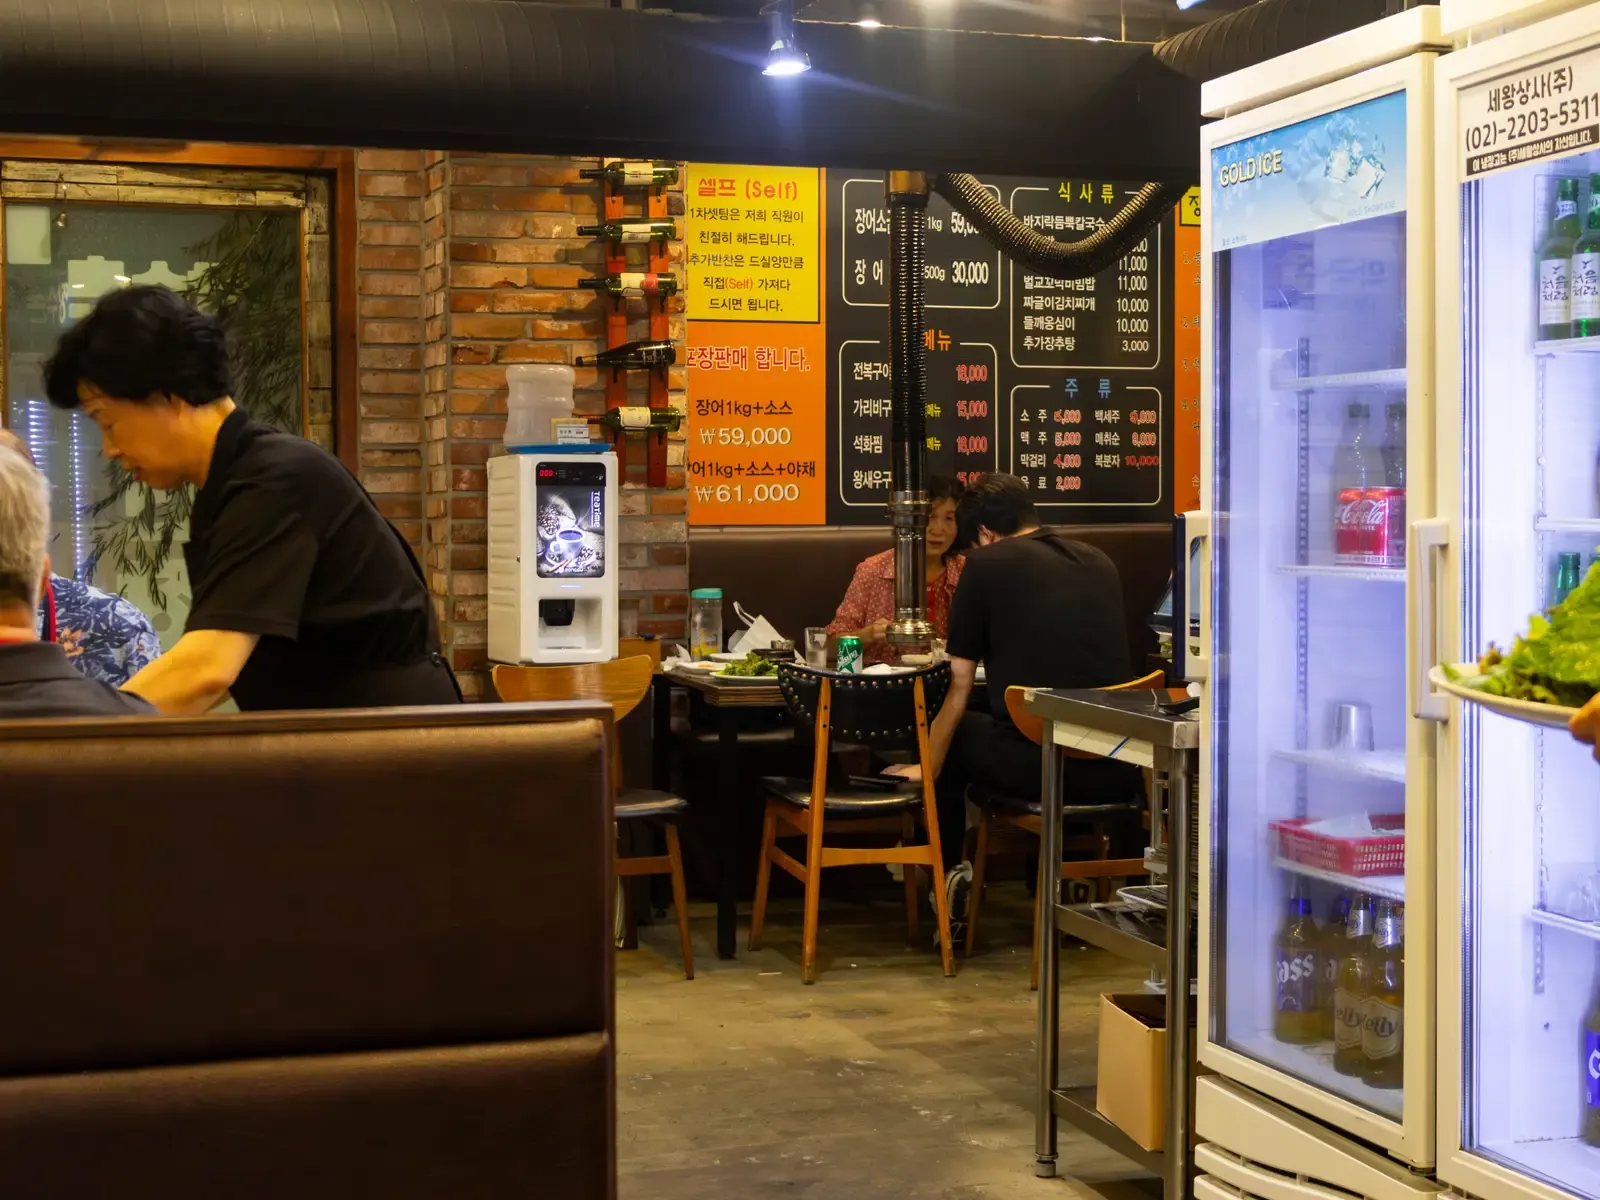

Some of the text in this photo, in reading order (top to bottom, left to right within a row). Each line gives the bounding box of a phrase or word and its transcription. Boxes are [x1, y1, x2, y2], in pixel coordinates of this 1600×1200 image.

[1487, 66, 1572, 112] 세왕상사(주)
[1466, 92, 1599, 151] (02)-2203-5311
[1219, 149, 1283, 187] GOLD ICE
[698, 178, 798, 200] 셀프 (Self)
[690, 207, 804, 223] 1차셋팅은 저희 직원이
[855, 208, 890, 234] 장어소
[927, 216, 942, 232] 1kg
[1023, 214, 1106, 231] 바지락듬뿍칼국수
[699, 230, 795, 246] 친절히 해드립니다.
[689, 253, 804, 269] 추가반찬은 드실양만큼
[952, 261, 989, 287] 30,000
[703, 276, 790, 291] 직접(Self) 가져다
[1118, 276, 1148, 292] 11,000
[709, 298, 784, 312] 드시면 됩니다.
[1023, 295, 1149, 314] 짜글이김치찌개 10,000
[1023, 316, 1149, 334] 들깨옹심이 10,000
[1023, 335, 1149, 352] 추가장추탕 3,000
[754, 346, 811, 371] 합니다.
[696, 399, 793, 417] 장어1kg+소스
[853, 399, 892, 418] 가리비구
[1094, 410, 1120, 424] 백세주
[700, 427, 792, 447] ₩59,000
[853, 435, 883, 454] 석화찜
[687, 460, 816, 478] 어1kg+소스+야채
[1020, 454, 1047, 468] 막걸리
[1094, 454, 1120, 468] 복분자
[853, 470, 892, 489] 왕새우구
[1056, 476, 1081, 491] 2,000
[695, 484, 800, 504] ₩61,000
[1336, 1008, 1361, 1028] elly
